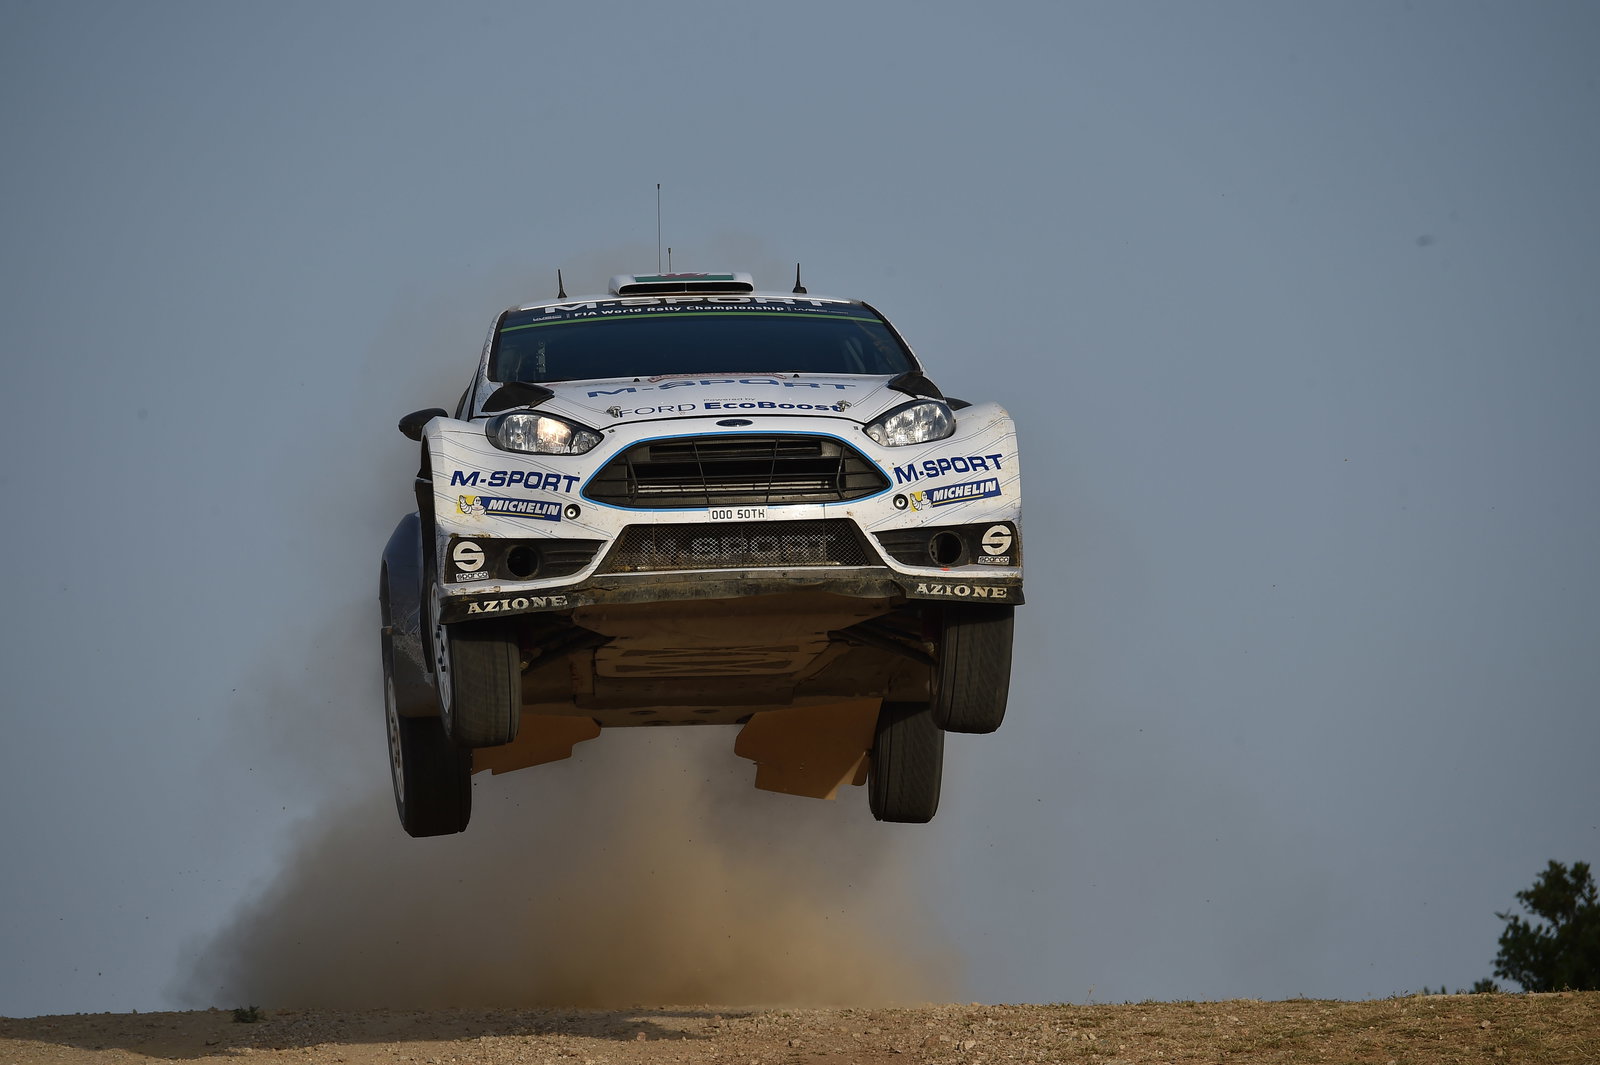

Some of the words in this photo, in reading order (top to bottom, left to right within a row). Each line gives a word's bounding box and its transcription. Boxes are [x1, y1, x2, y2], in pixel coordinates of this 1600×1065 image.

[574, 310, 598, 318] FIA
[601, 307, 642, 315] World
[587, 379, 857, 398] M-SPORT
[619, 403, 696, 418] FORD
[704, 401, 843, 413] EcoBoost
[893, 453, 1003, 484] M-SPORT
[450, 470, 580, 493] M-SPORT
[932, 479, 997, 502] MICHELIN
[486, 499, 561, 517] MICHELIN
[916, 583, 1008, 599] AZIONE
[467, 595, 569, 615] AZIONE
